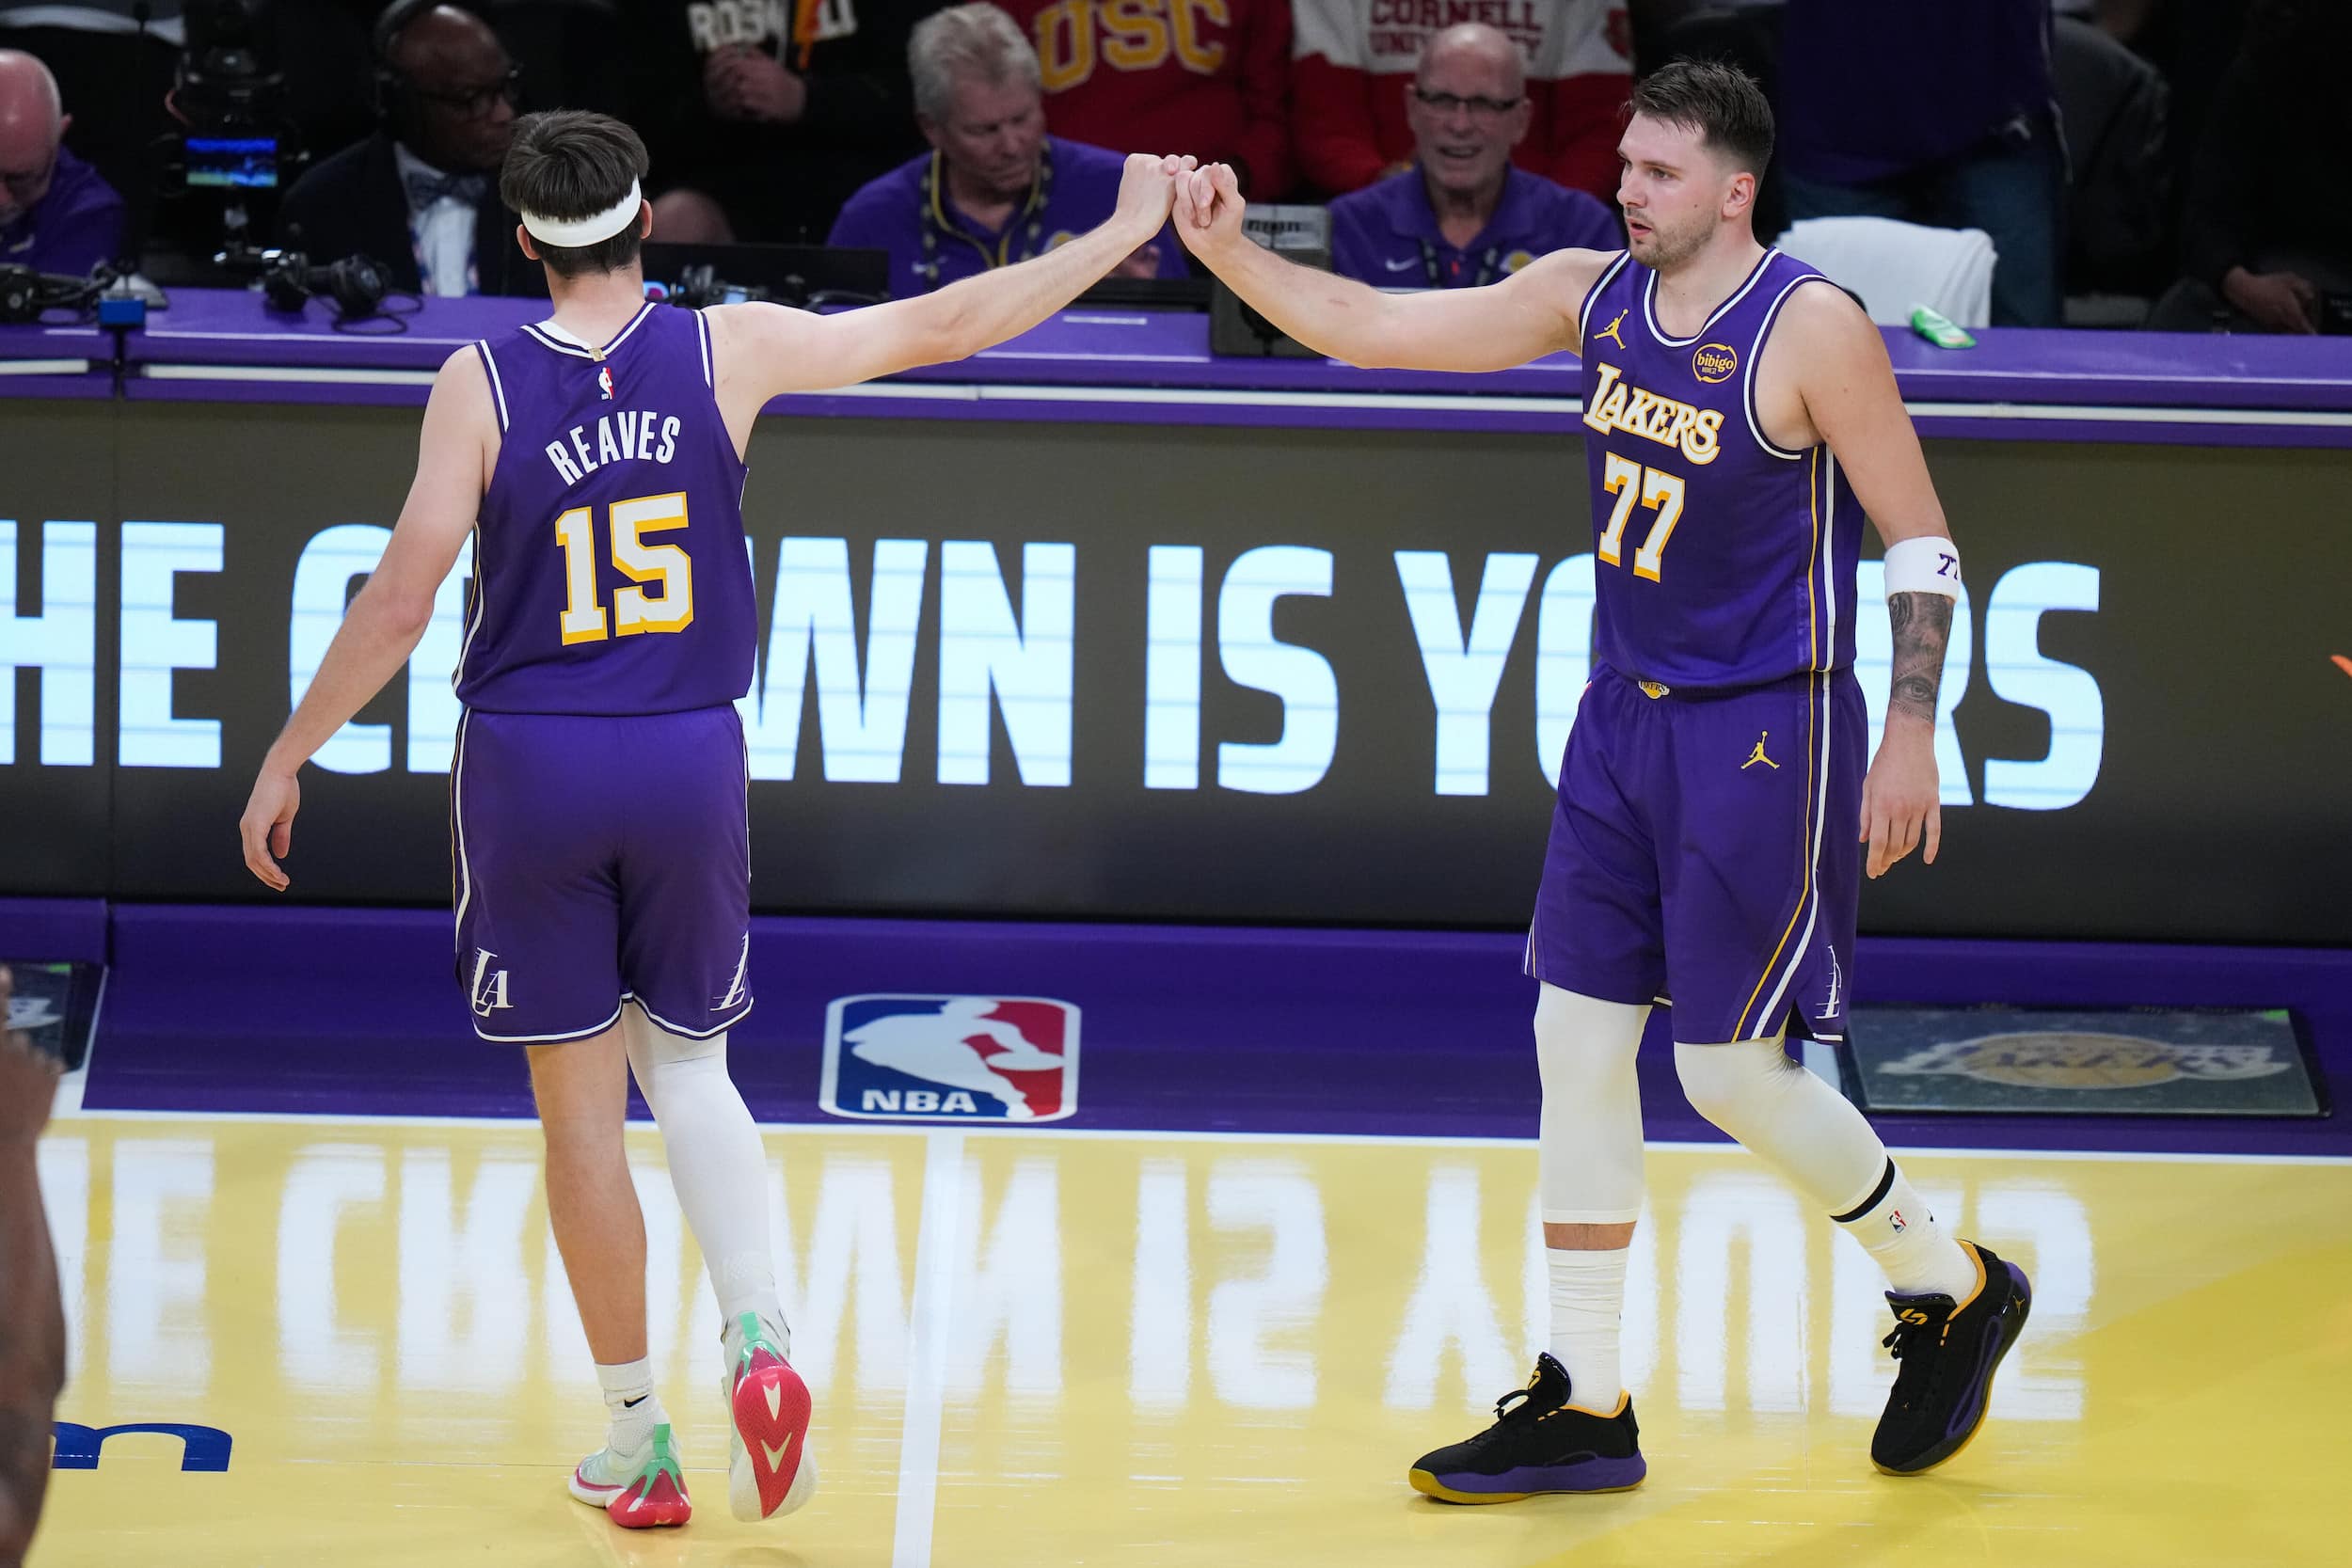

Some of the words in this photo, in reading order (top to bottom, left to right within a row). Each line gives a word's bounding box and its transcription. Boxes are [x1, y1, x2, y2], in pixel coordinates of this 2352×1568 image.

[1035, 0, 1230, 91] USC
[1697, 353, 1734, 372] bibigo
[545, 410, 681, 486] REAVES
[1583, 362, 1724, 465] LAKERS
[1598, 451, 1685, 583] 77
[555, 491, 694, 646] 15
[290, 524, 1075, 788] CWN
[1144, 545, 1338, 795] IS
[471, 946, 514, 1017] LA
[862, 1089, 977, 1113] NBA
